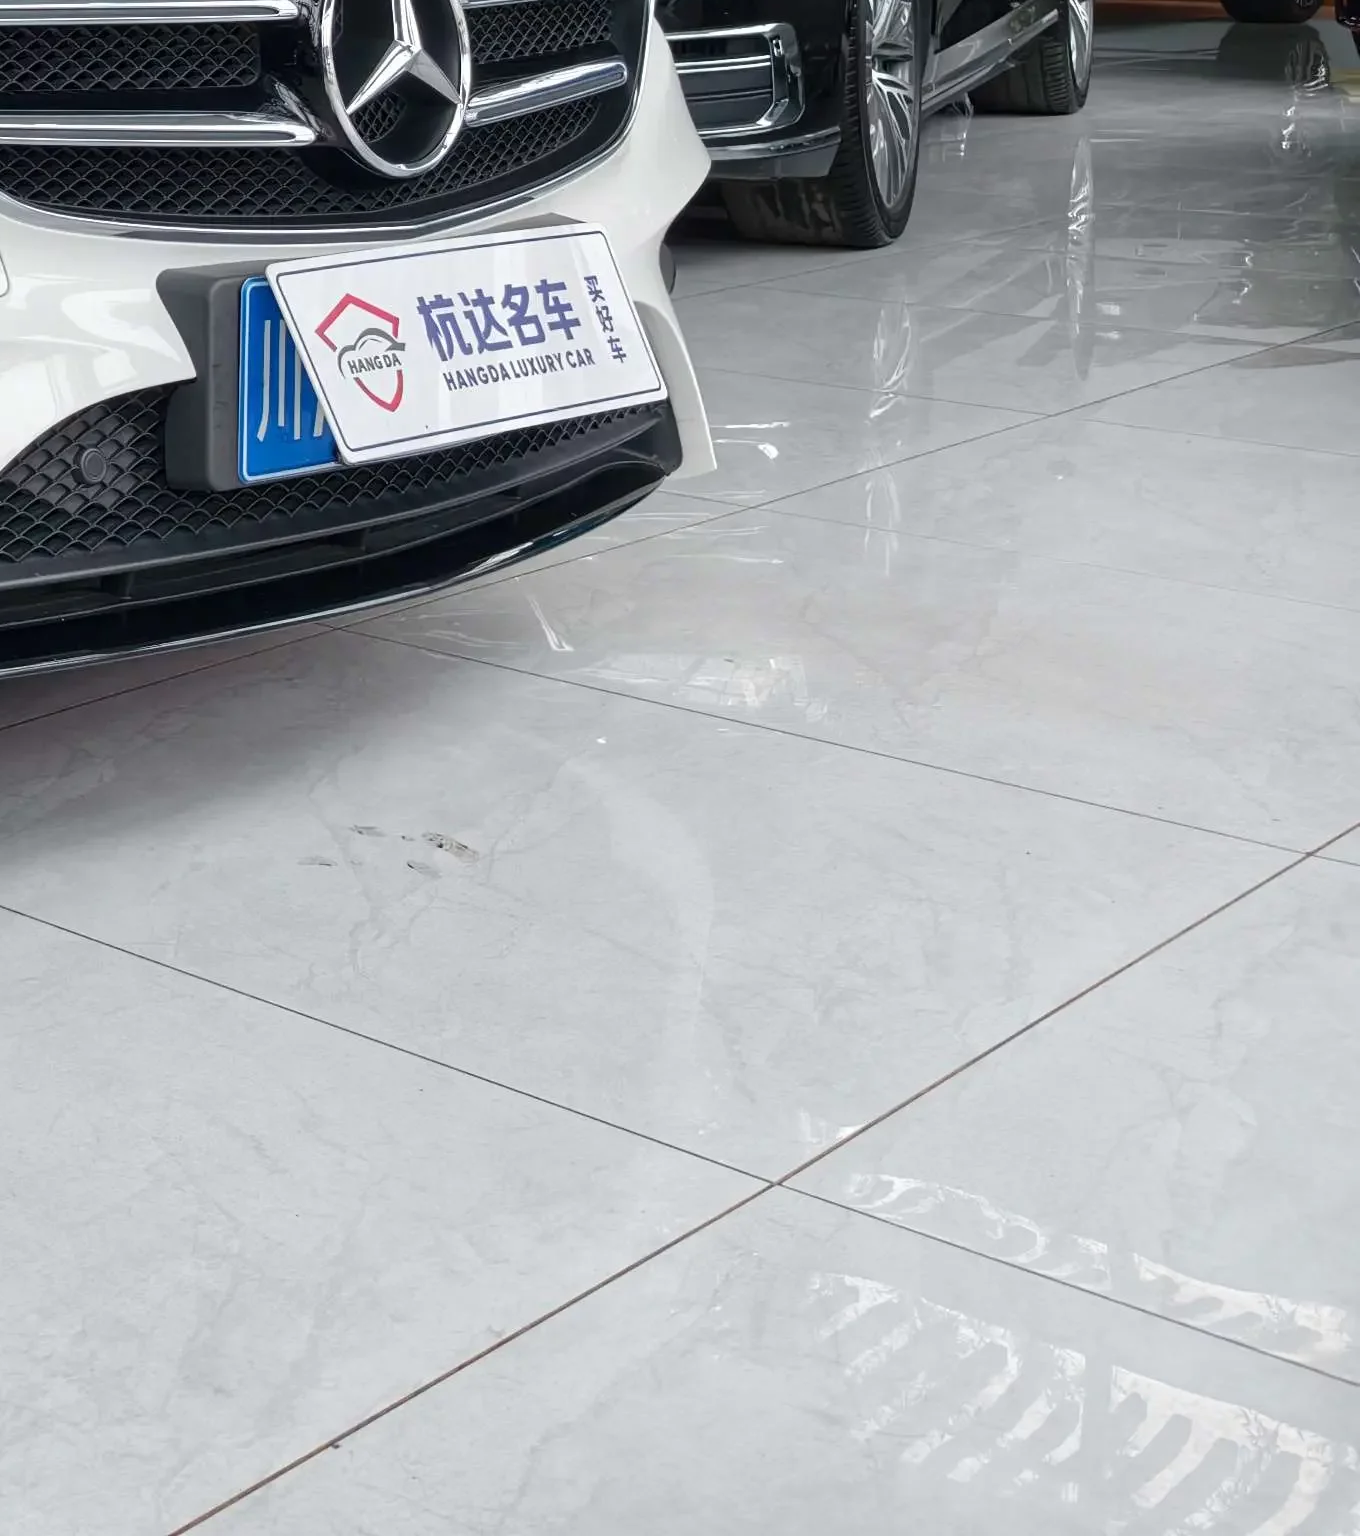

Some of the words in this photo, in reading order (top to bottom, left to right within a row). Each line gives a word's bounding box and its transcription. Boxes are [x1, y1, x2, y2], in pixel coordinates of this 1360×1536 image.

[416, 279, 581, 362] 杭达名车
[256, 319, 325, 443] 川
[347, 355, 383, 375] HANG
[384, 353, 402, 368] DA
[443, 363, 510, 391] HANGDA
[513, 353, 564, 379] LUXURY
[566, 348, 595, 369] CAR
